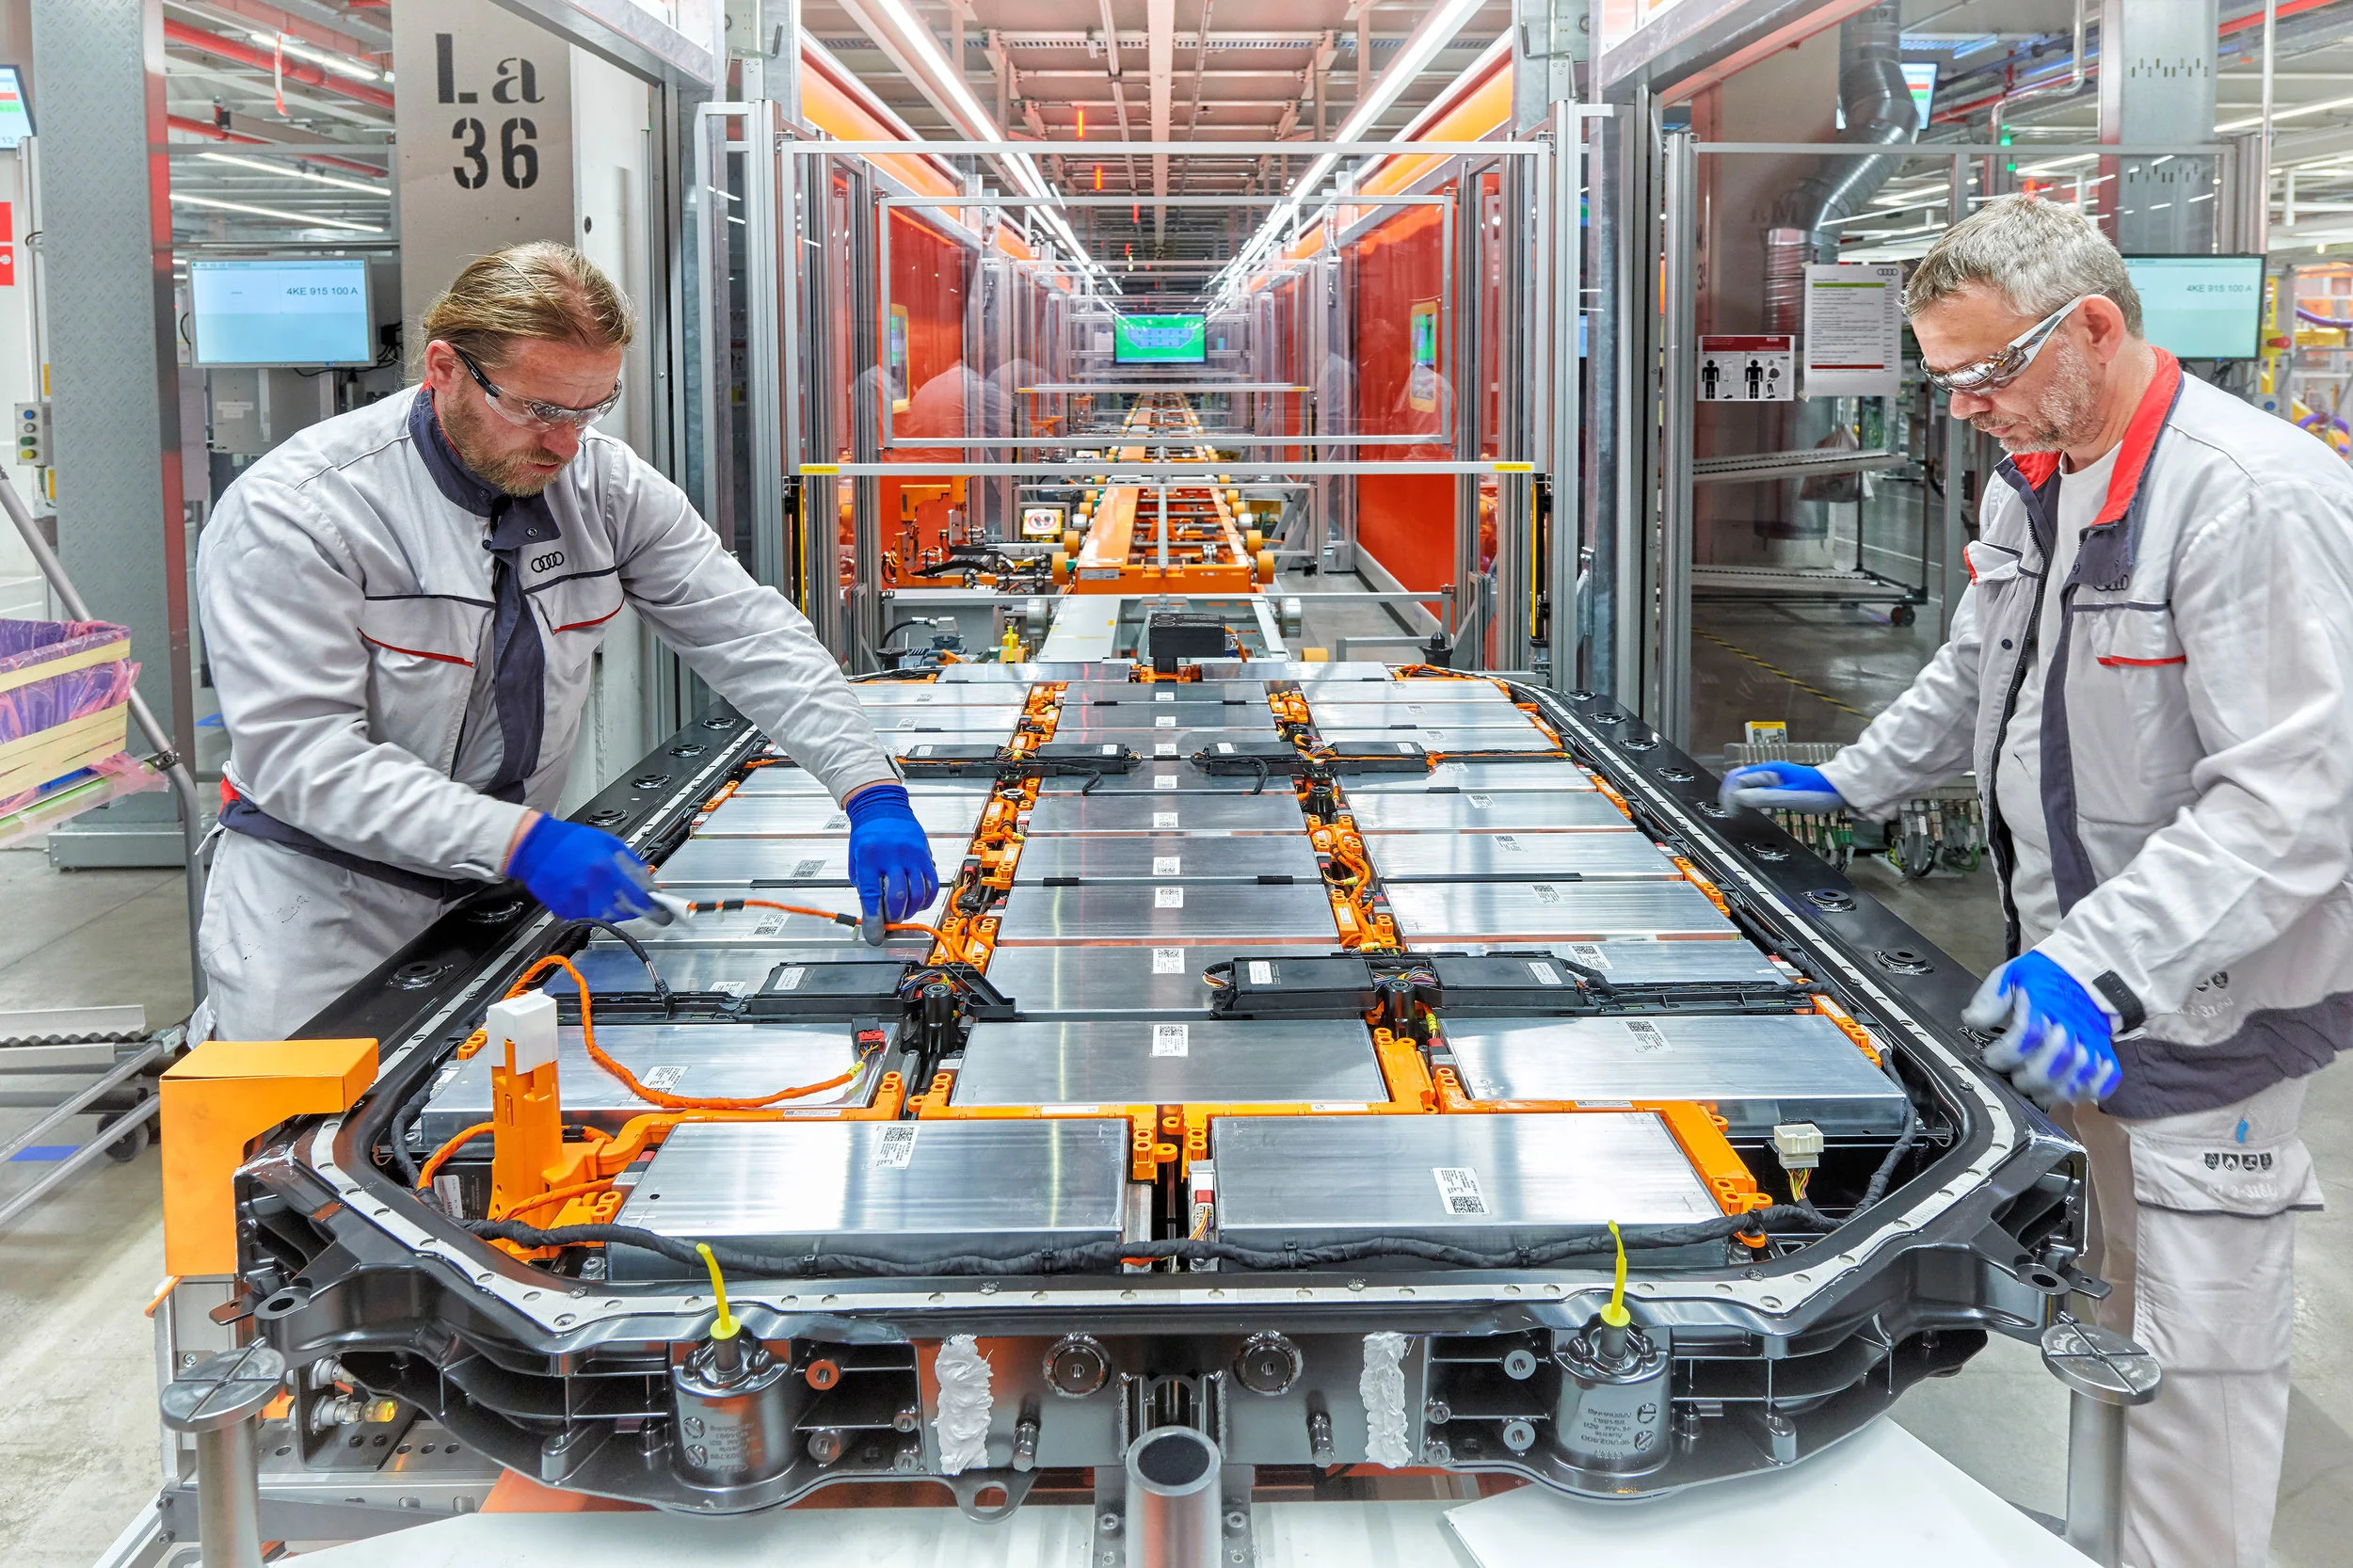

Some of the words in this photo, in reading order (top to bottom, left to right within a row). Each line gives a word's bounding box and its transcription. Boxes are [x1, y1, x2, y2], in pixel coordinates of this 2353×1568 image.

[435, 33, 545, 104] La
[452, 117, 538, 189] 36
[286, 287, 307, 296] 4KE
[310, 287, 328, 296] 915
